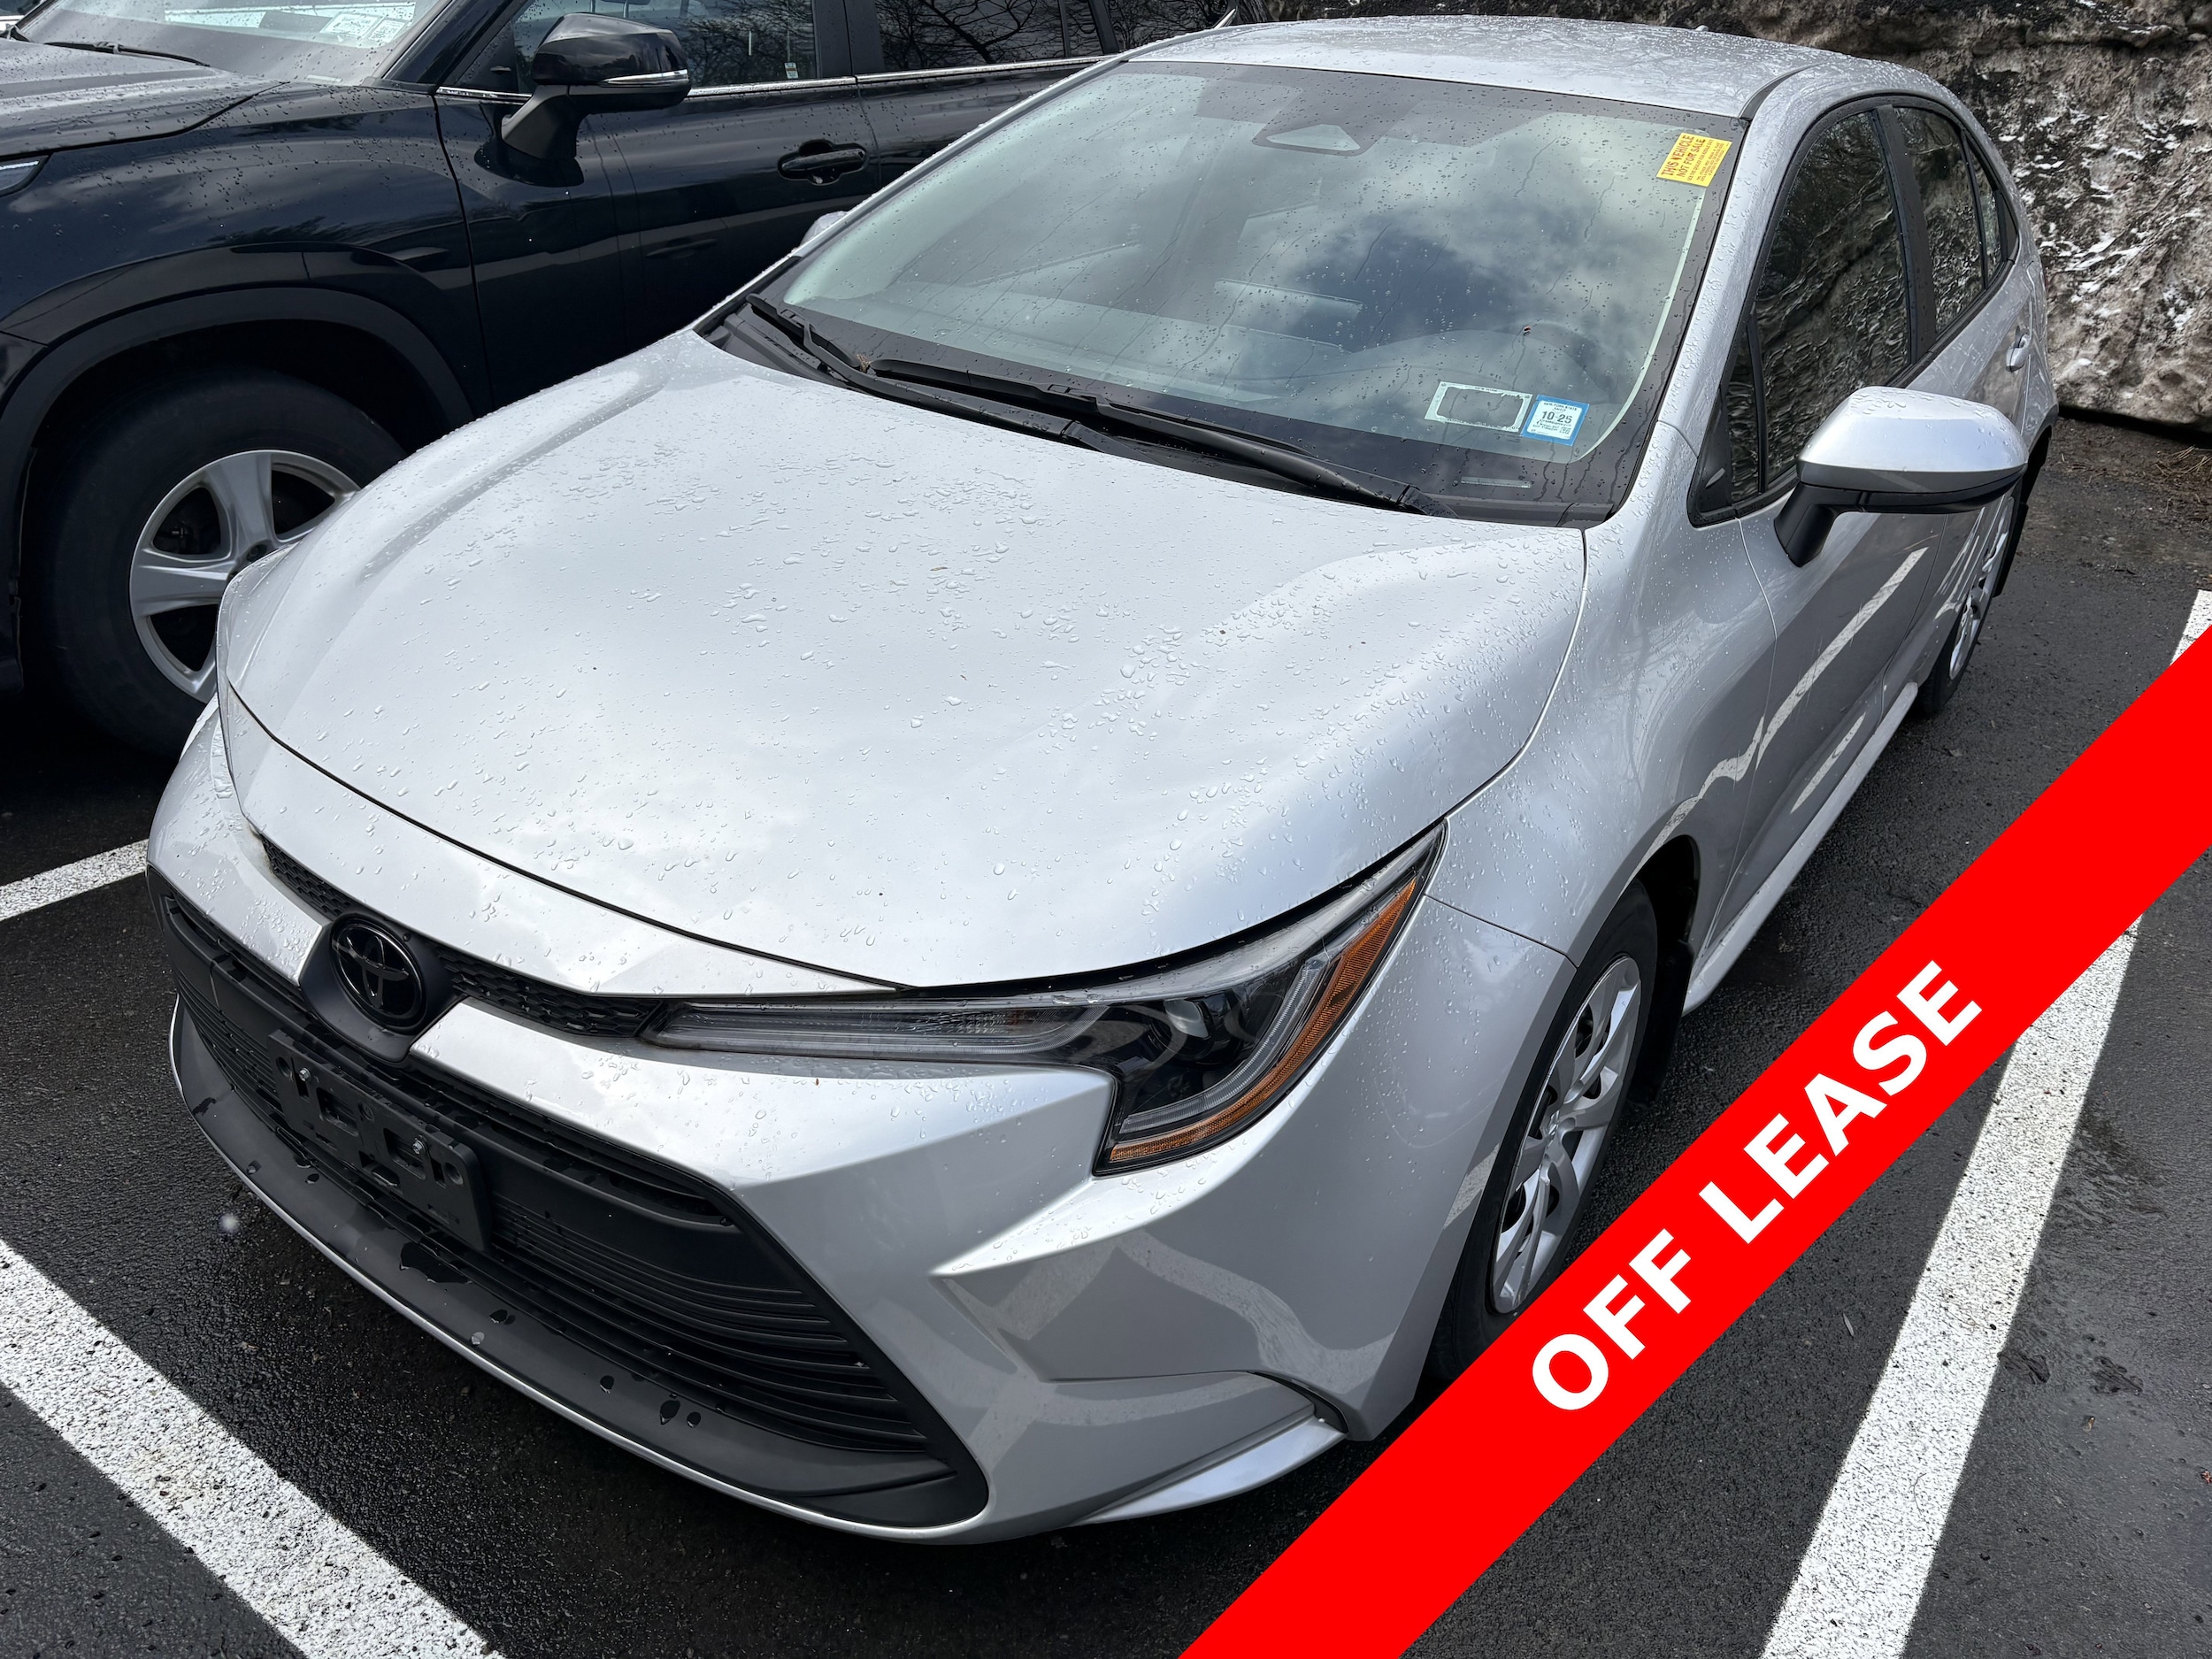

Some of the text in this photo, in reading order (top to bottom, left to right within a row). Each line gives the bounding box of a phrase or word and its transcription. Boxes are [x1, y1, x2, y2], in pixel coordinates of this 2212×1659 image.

[1661, 135, 1694, 176] THIS VEHICLE
[1677, 139, 1706, 177] NOT FOR SALE
